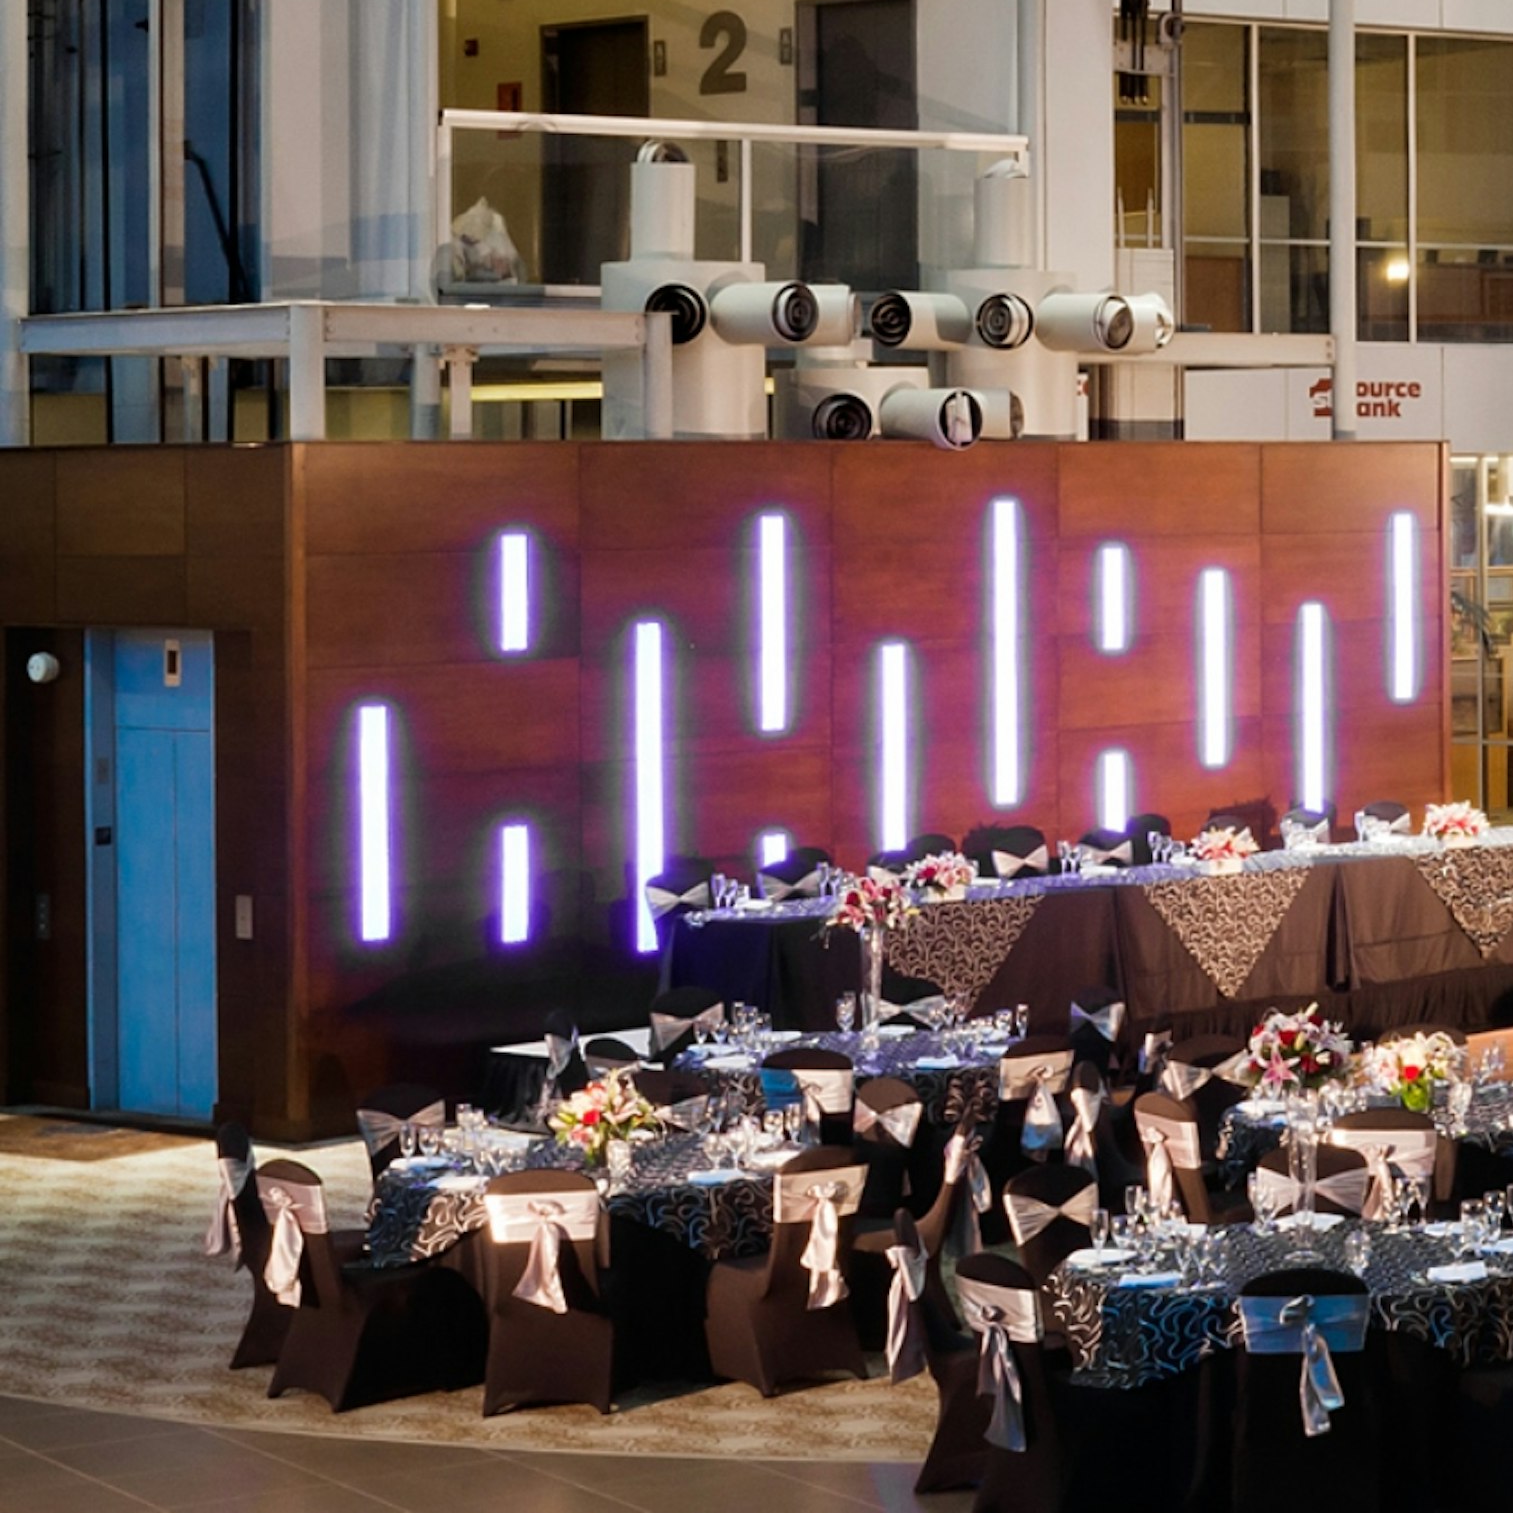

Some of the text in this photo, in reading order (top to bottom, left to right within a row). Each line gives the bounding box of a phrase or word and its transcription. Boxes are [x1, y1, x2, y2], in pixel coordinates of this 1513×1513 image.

[699, 10, 747, 96] 2
[1355, 381, 1421, 399] ource
[1355, 399, 1401, 417] ank
